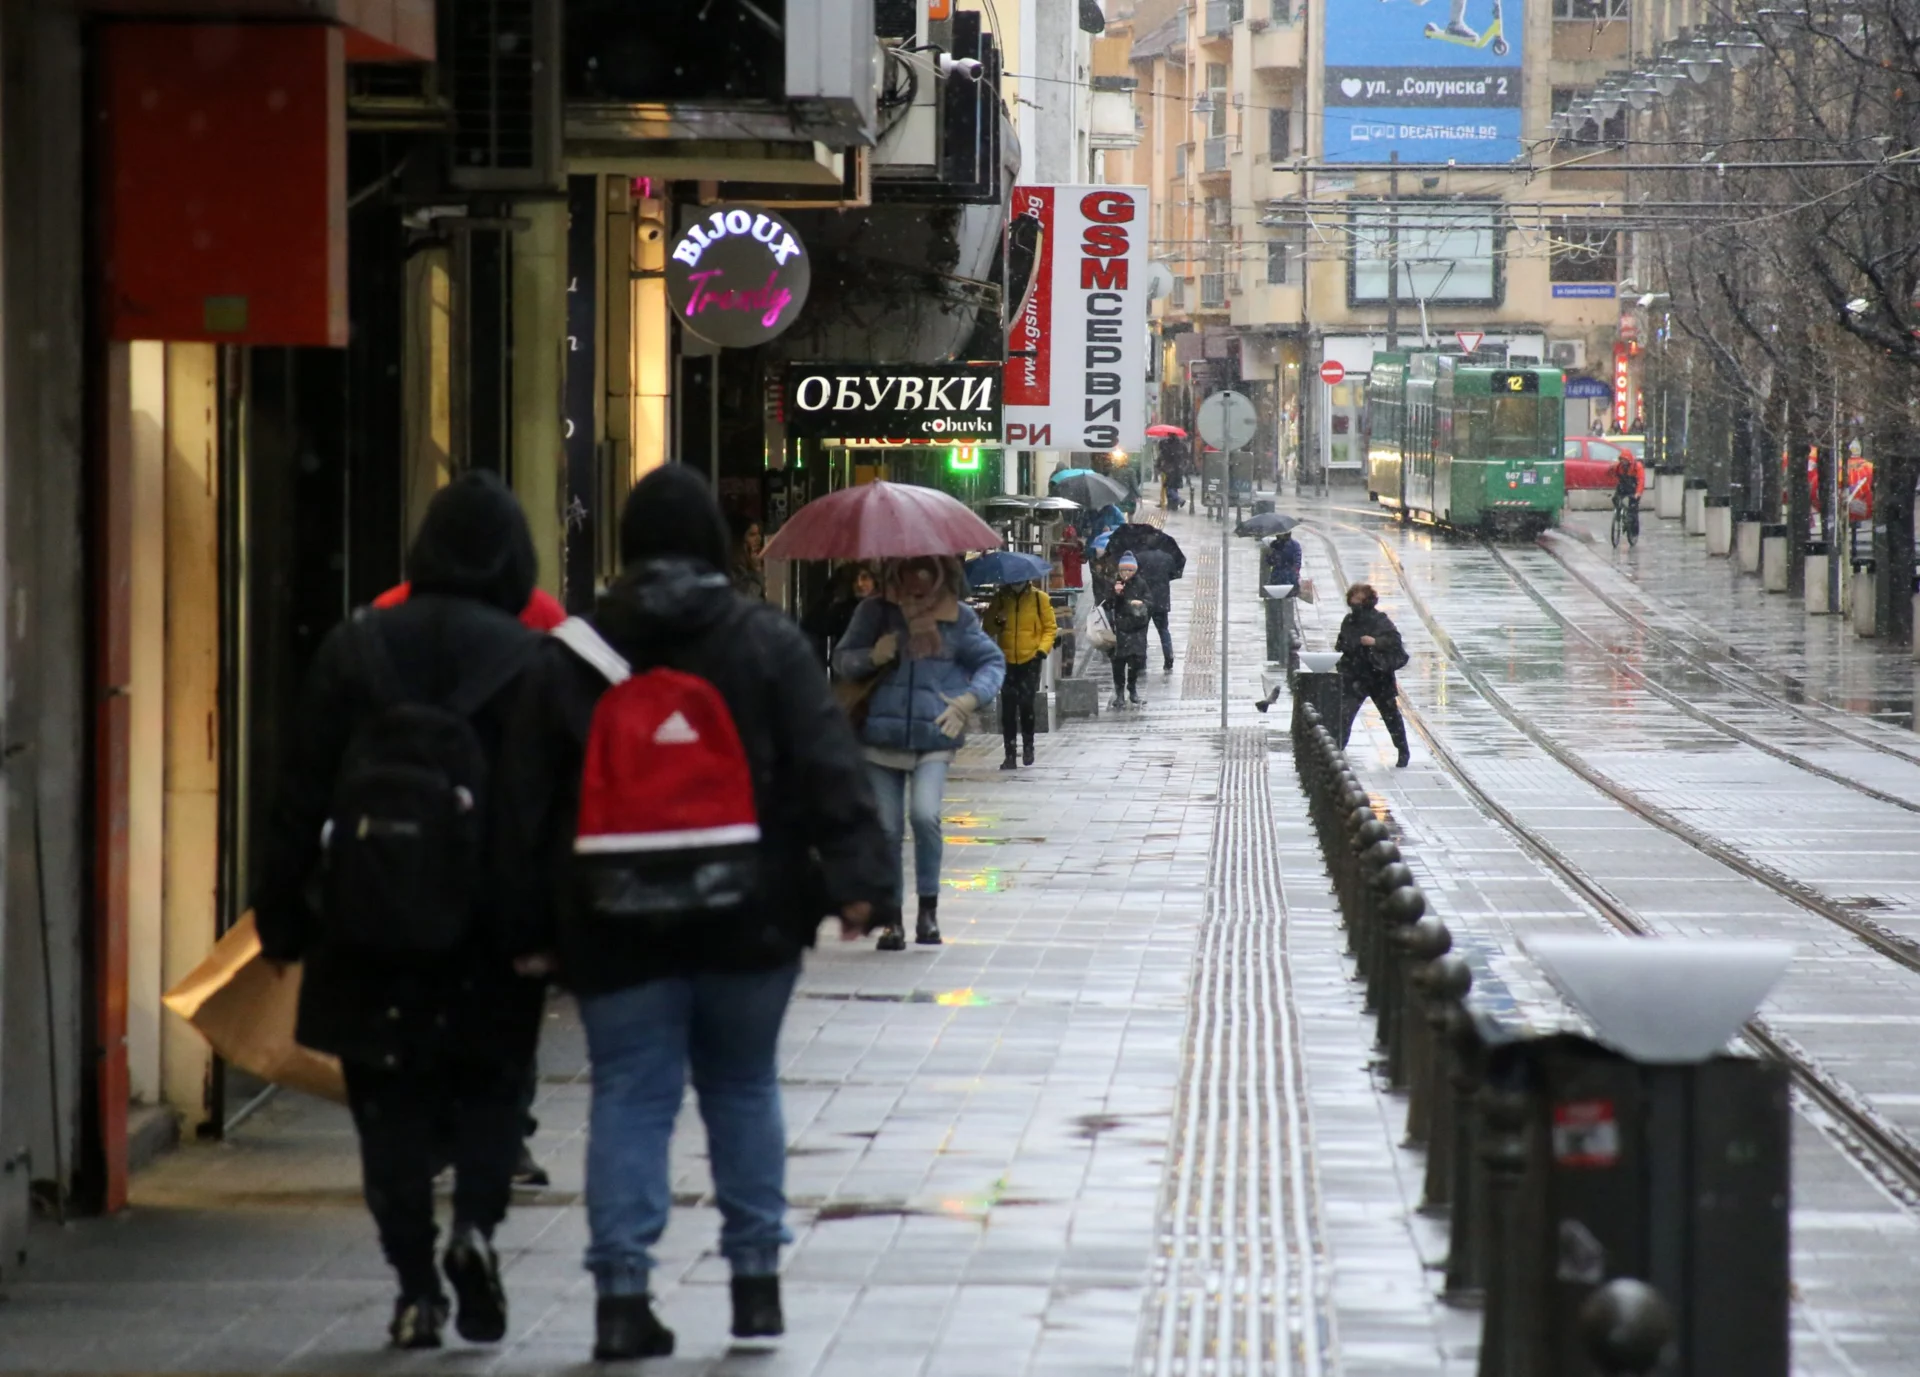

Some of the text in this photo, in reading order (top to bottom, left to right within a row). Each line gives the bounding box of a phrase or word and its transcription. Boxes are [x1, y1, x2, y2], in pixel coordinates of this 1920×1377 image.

[1366, 80, 1391, 98] ул.
[1496, 77, 1508, 95] 2
[1399, 125, 1498, 140] DECATHLON.BG
[672, 209, 801, 267] BIJOUX
[685, 269, 792, 328] Trendy
[1079, 190, 1136, 449] GSM СЕРВИЗ
[796, 375, 993, 412] ОБУВКИ
[1507, 375, 1523, 391] 12
